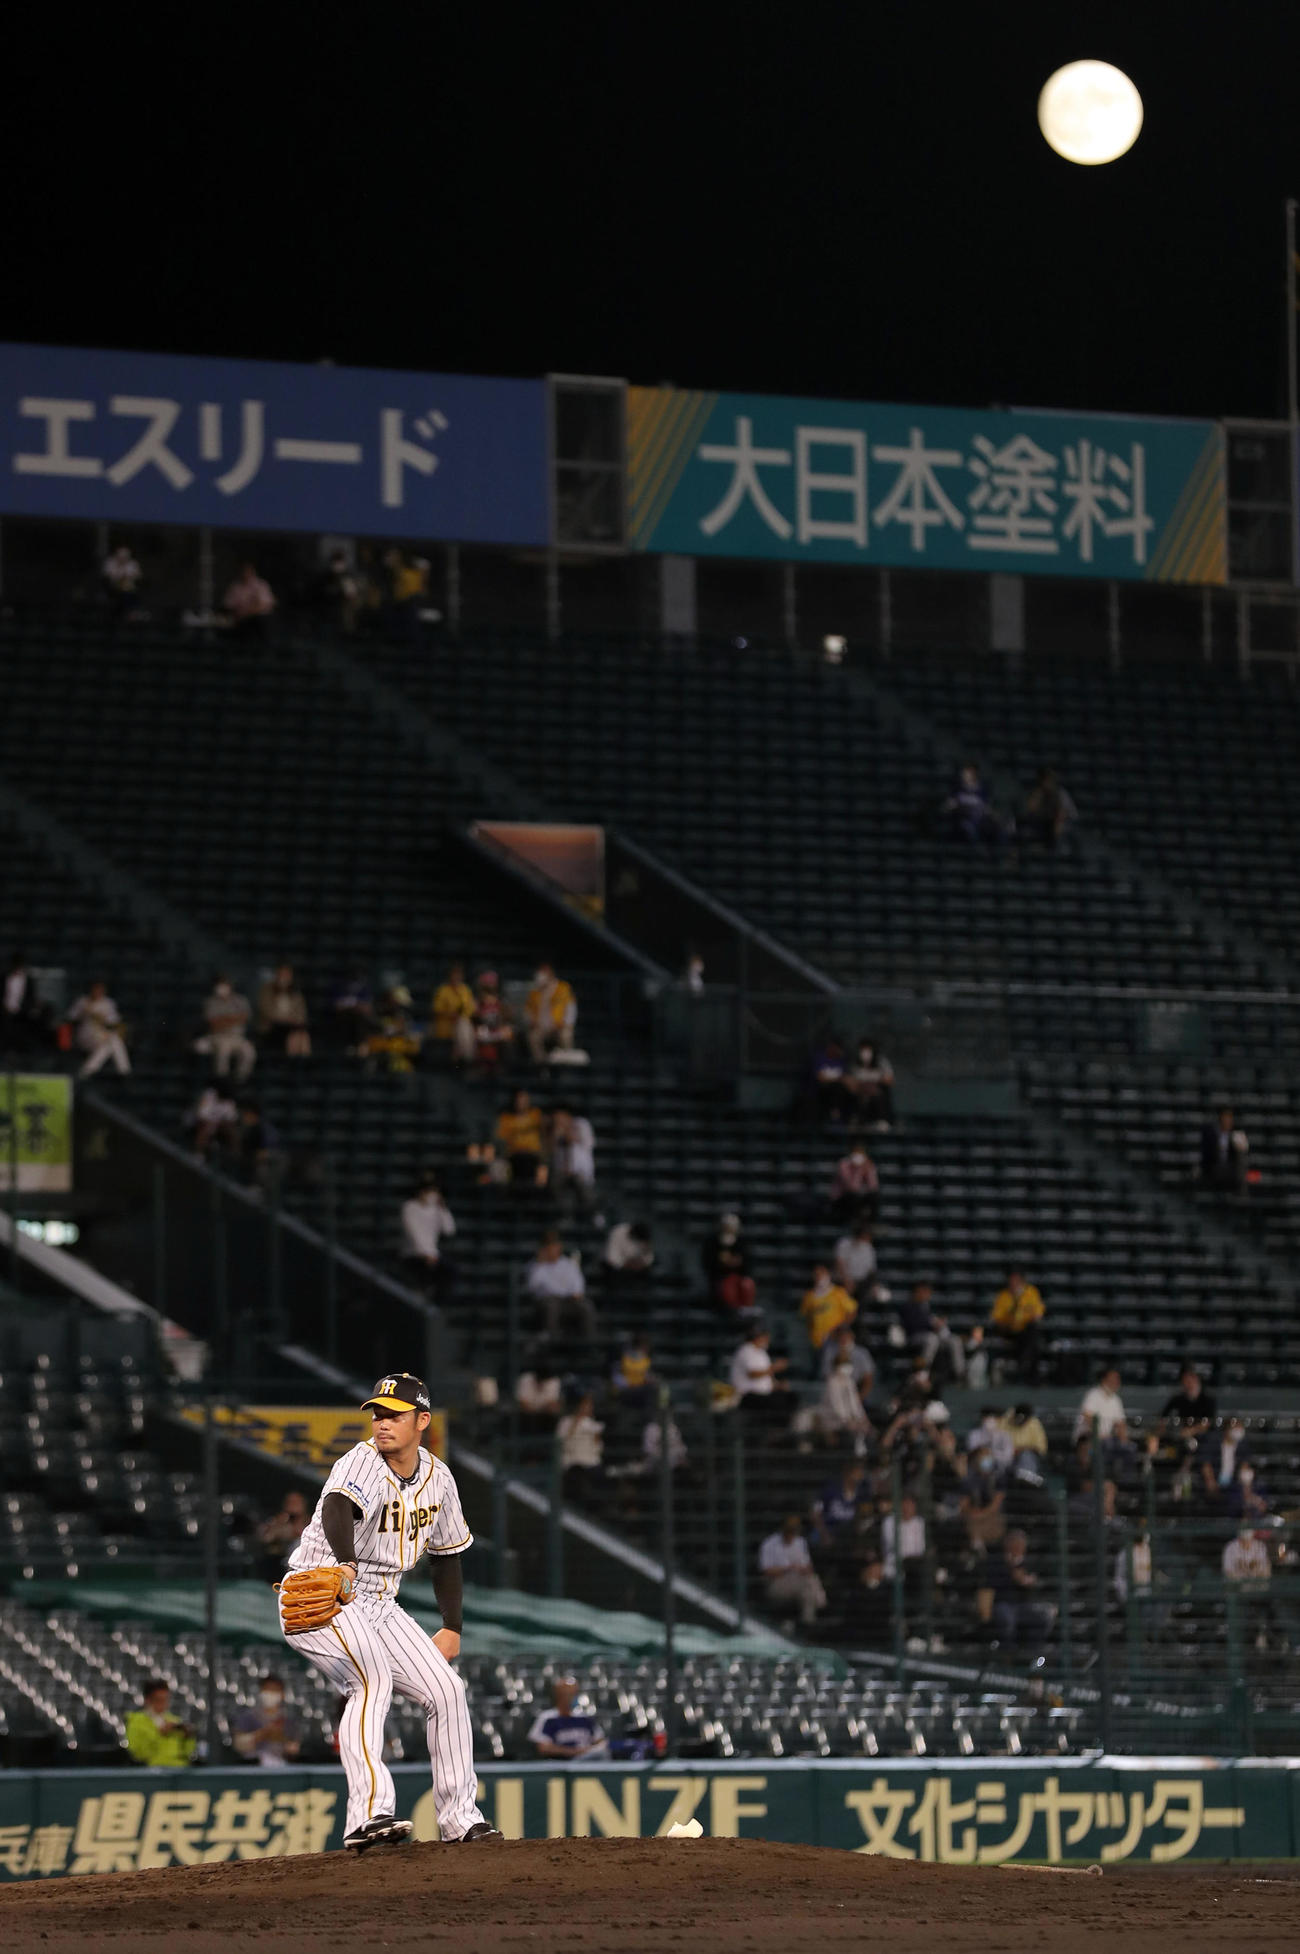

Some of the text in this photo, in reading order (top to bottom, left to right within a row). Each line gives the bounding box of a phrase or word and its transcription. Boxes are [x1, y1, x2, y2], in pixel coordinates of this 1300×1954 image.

[14, 396, 450, 509] エスリード
[698, 416, 1155, 566] 大日本塗料
[845, 1776, 1245, 1863] 文化シャッター
